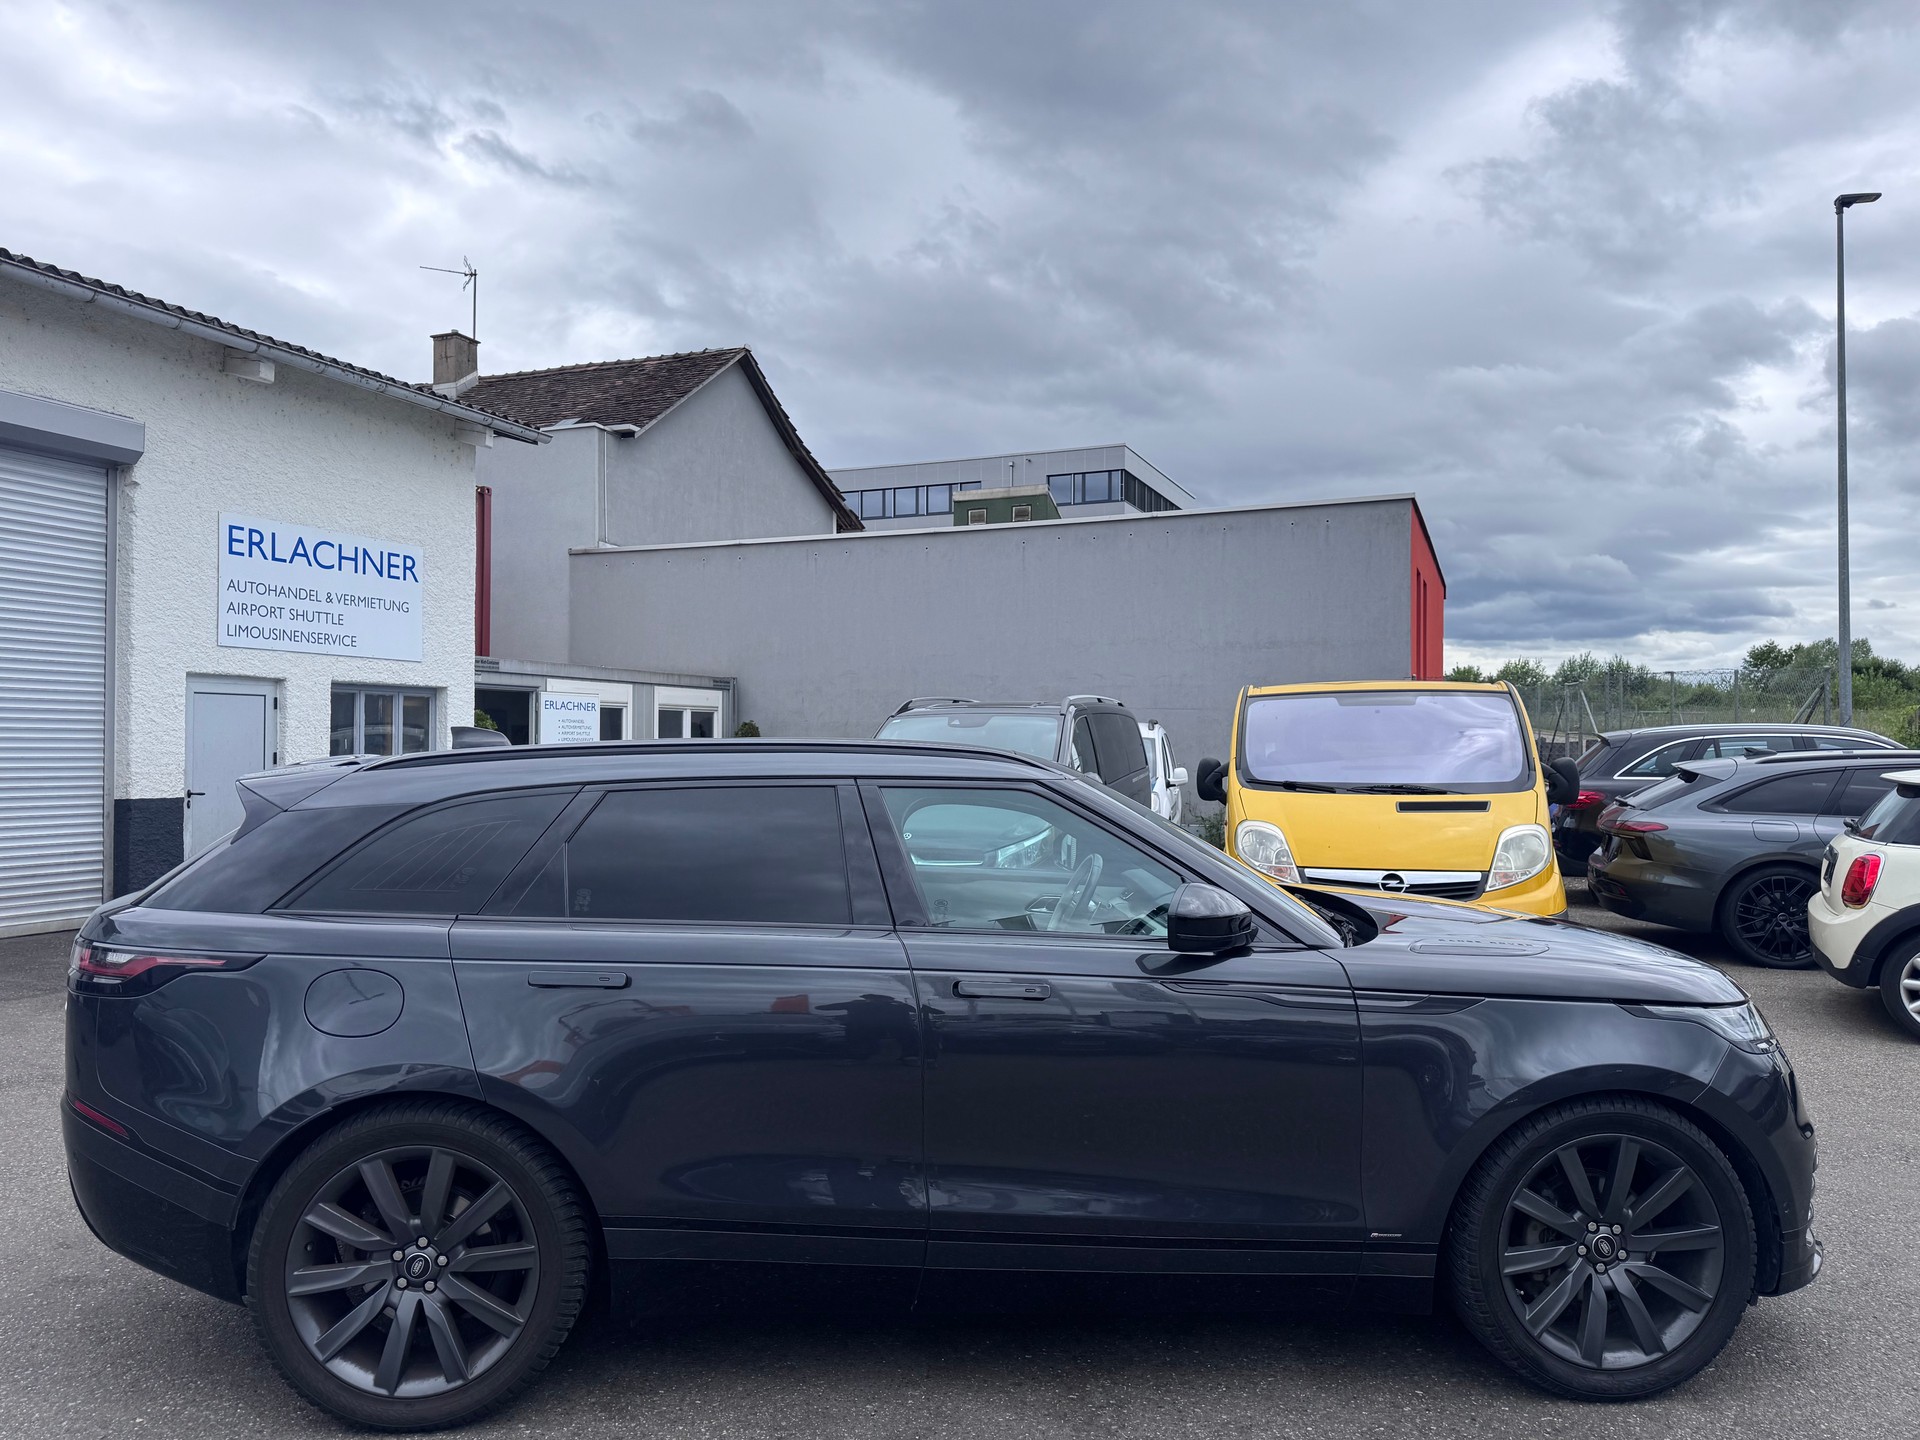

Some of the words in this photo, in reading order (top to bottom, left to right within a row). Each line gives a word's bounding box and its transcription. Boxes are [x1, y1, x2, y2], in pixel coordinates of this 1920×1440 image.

[228, 524, 419, 583] ERLACHNER
[226, 579, 322, 603] AUTOHANDEL
[325, 592, 334, 604] &
[335, 593, 410, 614] VERMIETUNG
[226, 602, 285, 620] AIRPORT
[289, 608, 344, 626] SHUTTLE
[226, 624, 357, 648] LIMOUSINENSERVICE
[544, 700, 597, 712] ERLACHNER
